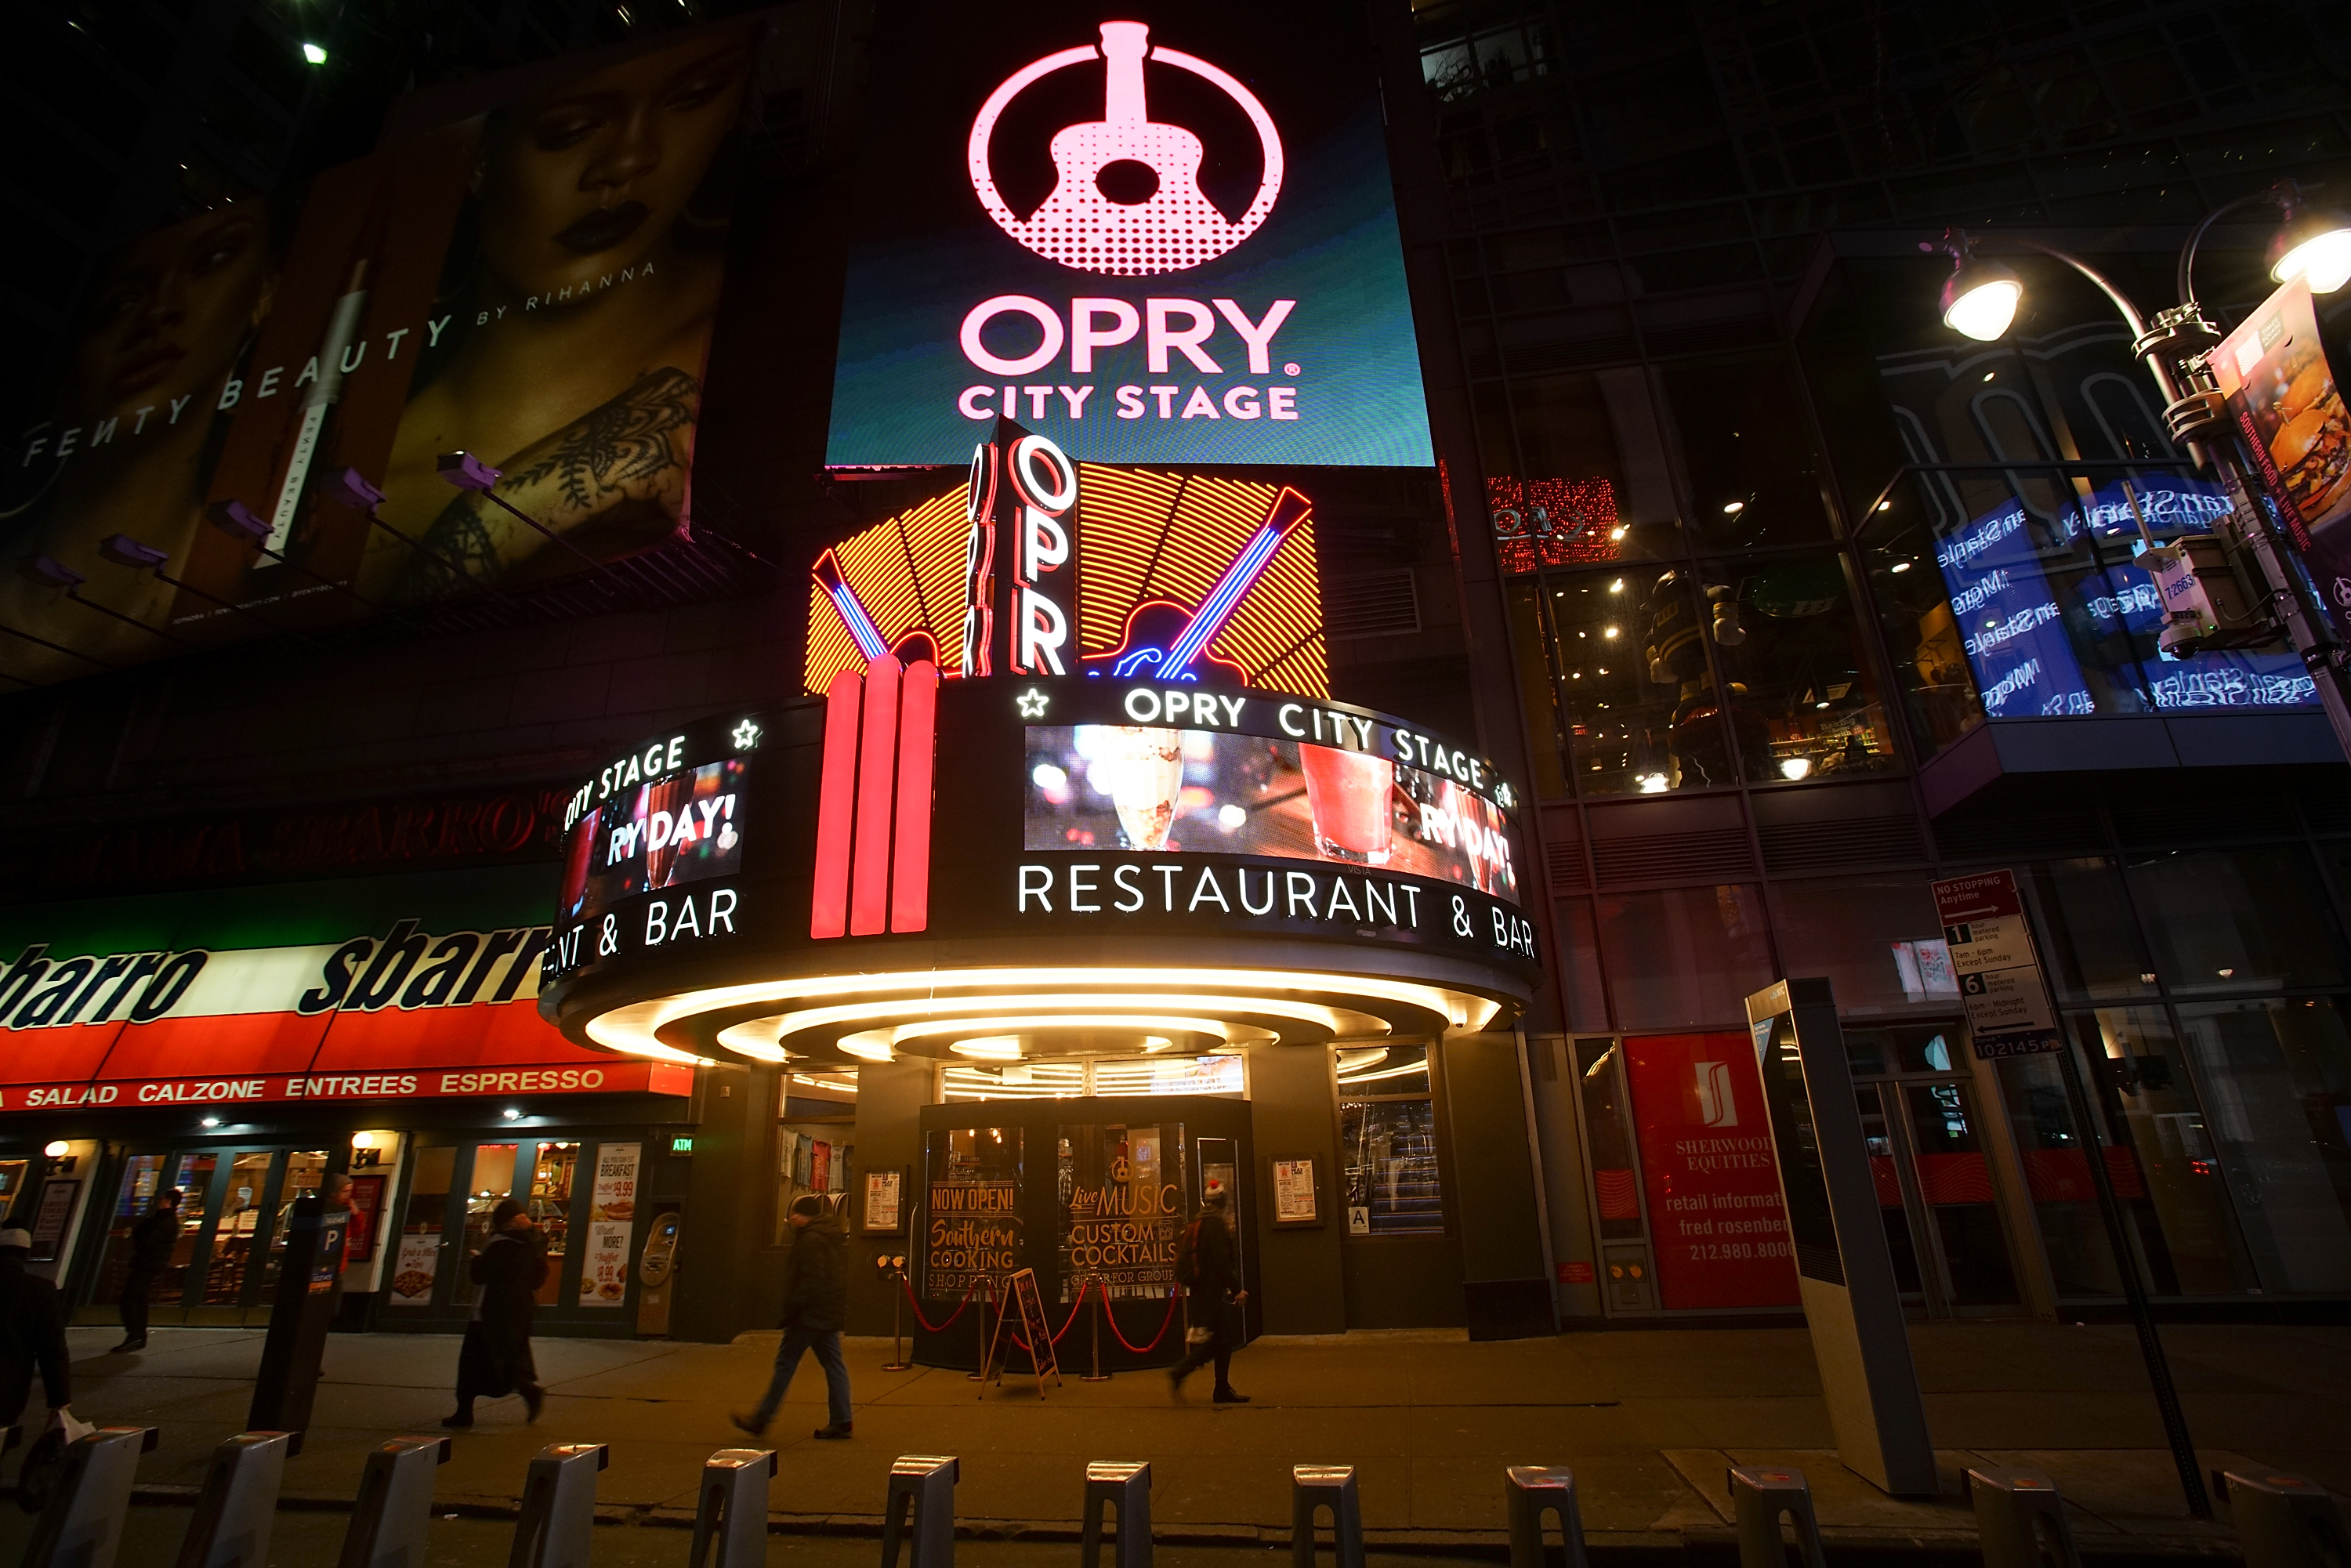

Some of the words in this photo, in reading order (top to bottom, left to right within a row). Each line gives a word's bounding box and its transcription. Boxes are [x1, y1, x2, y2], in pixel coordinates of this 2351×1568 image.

[2262, 317, 2279, 335] TIMES
[2262, 320, 2282, 343] SQUARE
[217, 315, 453, 411] BEAUTY
[476, 306, 509, 326] BY
[525, 261, 656, 311] RIHANNA
[2264, 328, 2282, 347] ALLIANCE
[958, 385, 1095, 421] CITY
[1116, 386, 1299, 422] STAGE
[2240, 411, 2266, 462] SOUTHERN
[2261, 459, 2278, 487] FOOD
[2278, 494, 2295, 521] LIVE
[2288, 518, 2311, 552] MUSIC
[1125, 688, 1246, 728] OPRY
[1279, 703, 1373, 751] CITY
[1392, 728, 1482, 788] STAGE
[564, 780, 594, 831] CITY
[599, 735, 686, 799] STAGE
[1348, 864, 1371, 875] VISTA
[1937, 885, 1951, 896] NO
[1952, 876, 2001, 893] STOPPING
[1940, 892, 1980, 905] Anytime
[1018, 864, 1421, 928] RESTAURANT
[1452, 895, 1474, 938] &
[1492, 906, 1534, 958] BAR
[600, 913, 618, 957] &
[644, 889, 737, 946] BAR
[1972, 925, 2000, 936] metered
[1951, 925, 1963, 943] 1
[1974, 932, 1999, 943] parking
[1954, 951, 1970, 960] 7am
[1976, 947, 1994, 957] 6pm
[1956, 957, 1982, 968] Except
[1983, 954, 2012, 965] Sunday
[296, 918, 553, 1016] sbarr
[0, 943, 208, 1031] barro
[1965, 975, 1980, 994] 6
[1987, 977, 2015, 987] metered
[1989, 984, 2014, 994] parking
[1969, 1002, 1986, 1012] 6pm
[1993, 997, 2025, 1008] Midnight
[1971, 1008, 1999, 1019] Except
[1998, 1006, 2027, 1018] Sunday
[1977, 1039, 2039, 1058] 102145
[25, 1085, 118, 1108] SALAD
[138, 1079, 266, 1103] CALZONE
[284, 1075, 418, 1098] ENTREES
[440, 1069, 604, 1093] ESPRESSO
[672, 1138, 693, 1151] ATM
[1675, 1136, 1773, 1156] SHERWOOD
[600, 1164, 635, 1177] BREAKFAST
[1686, 1152, 1771, 1175] EQUITIES
[932, 1189, 965, 1211] NOW
[967, 1188, 1014, 1211] OPEN!
[1068, 1186, 1099, 1210] Live
[1096, 1184, 1178, 1216] MUSIC
[1666, 1193, 1708, 1211] retail
[1712, 1191, 1783, 1210] informat
[1353, 1210, 1365, 1225] A
[1679, 1218, 1713, 1236] fred
[1717, 1216, 1789, 1234] rosenber
[324, 1229, 339, 1251] P
[601, 1235, 624, 1249] MORE?
[930, 1219, 1014, 1252] Southern
[1071, 1222, 1155, 1245] CUSTOM
[930, 1251, 1014, 1269] COOKING
[1070, 1242, 1176, 1267] COCKTAILS
[929, 1273, 1012, 1289] SHOPPNG
[1070, 1273, 1110, 1286] GRET
[1111, 1272, 1135, 1284] FOR
[1137, 1269, 1176, 1282] GROUP
